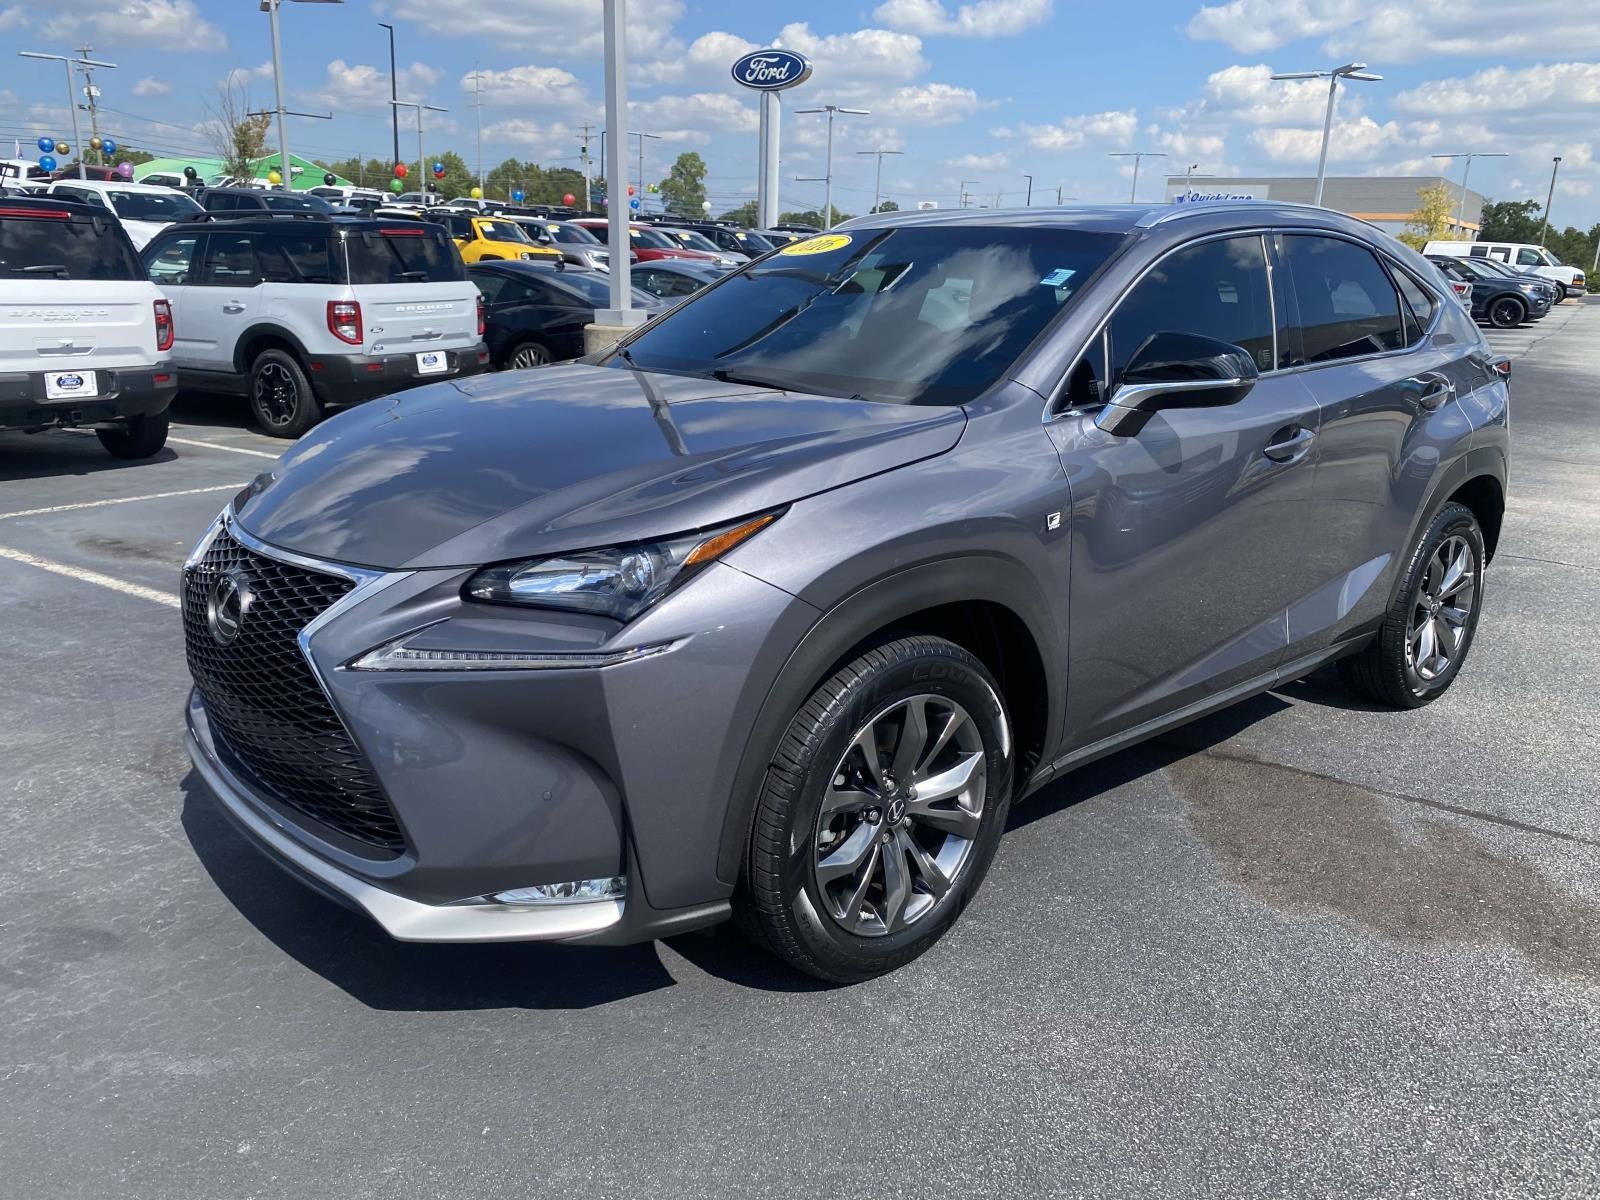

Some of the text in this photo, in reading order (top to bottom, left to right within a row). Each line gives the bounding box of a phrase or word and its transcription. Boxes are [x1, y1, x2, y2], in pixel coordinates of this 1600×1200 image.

[745, 57, 791, 82] Ford
[1191, 193, 1223, 202] Quick
[395, 303, 454, 312] BRONCO
